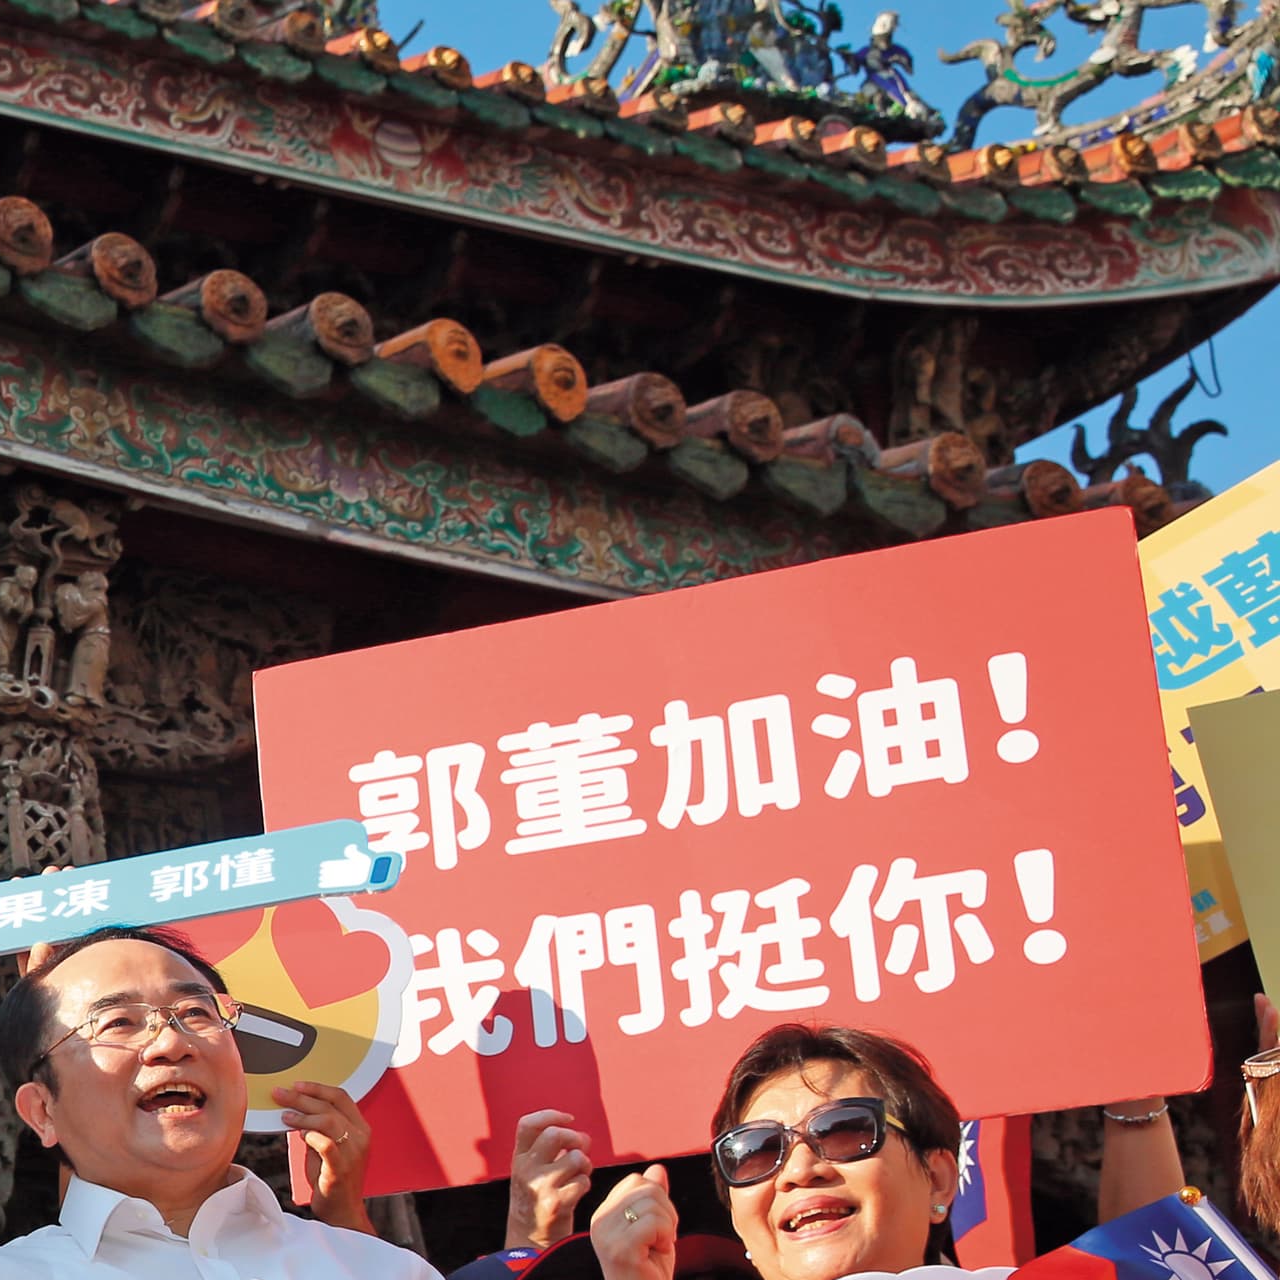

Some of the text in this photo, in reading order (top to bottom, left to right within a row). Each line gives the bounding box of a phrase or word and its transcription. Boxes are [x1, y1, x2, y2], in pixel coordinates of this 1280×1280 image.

[348, 652, 1040, 870] 郭董加油!
[149, 848, 276, 904] 郭懂
[386, 848, 1068, 1068] 我們挺你!
